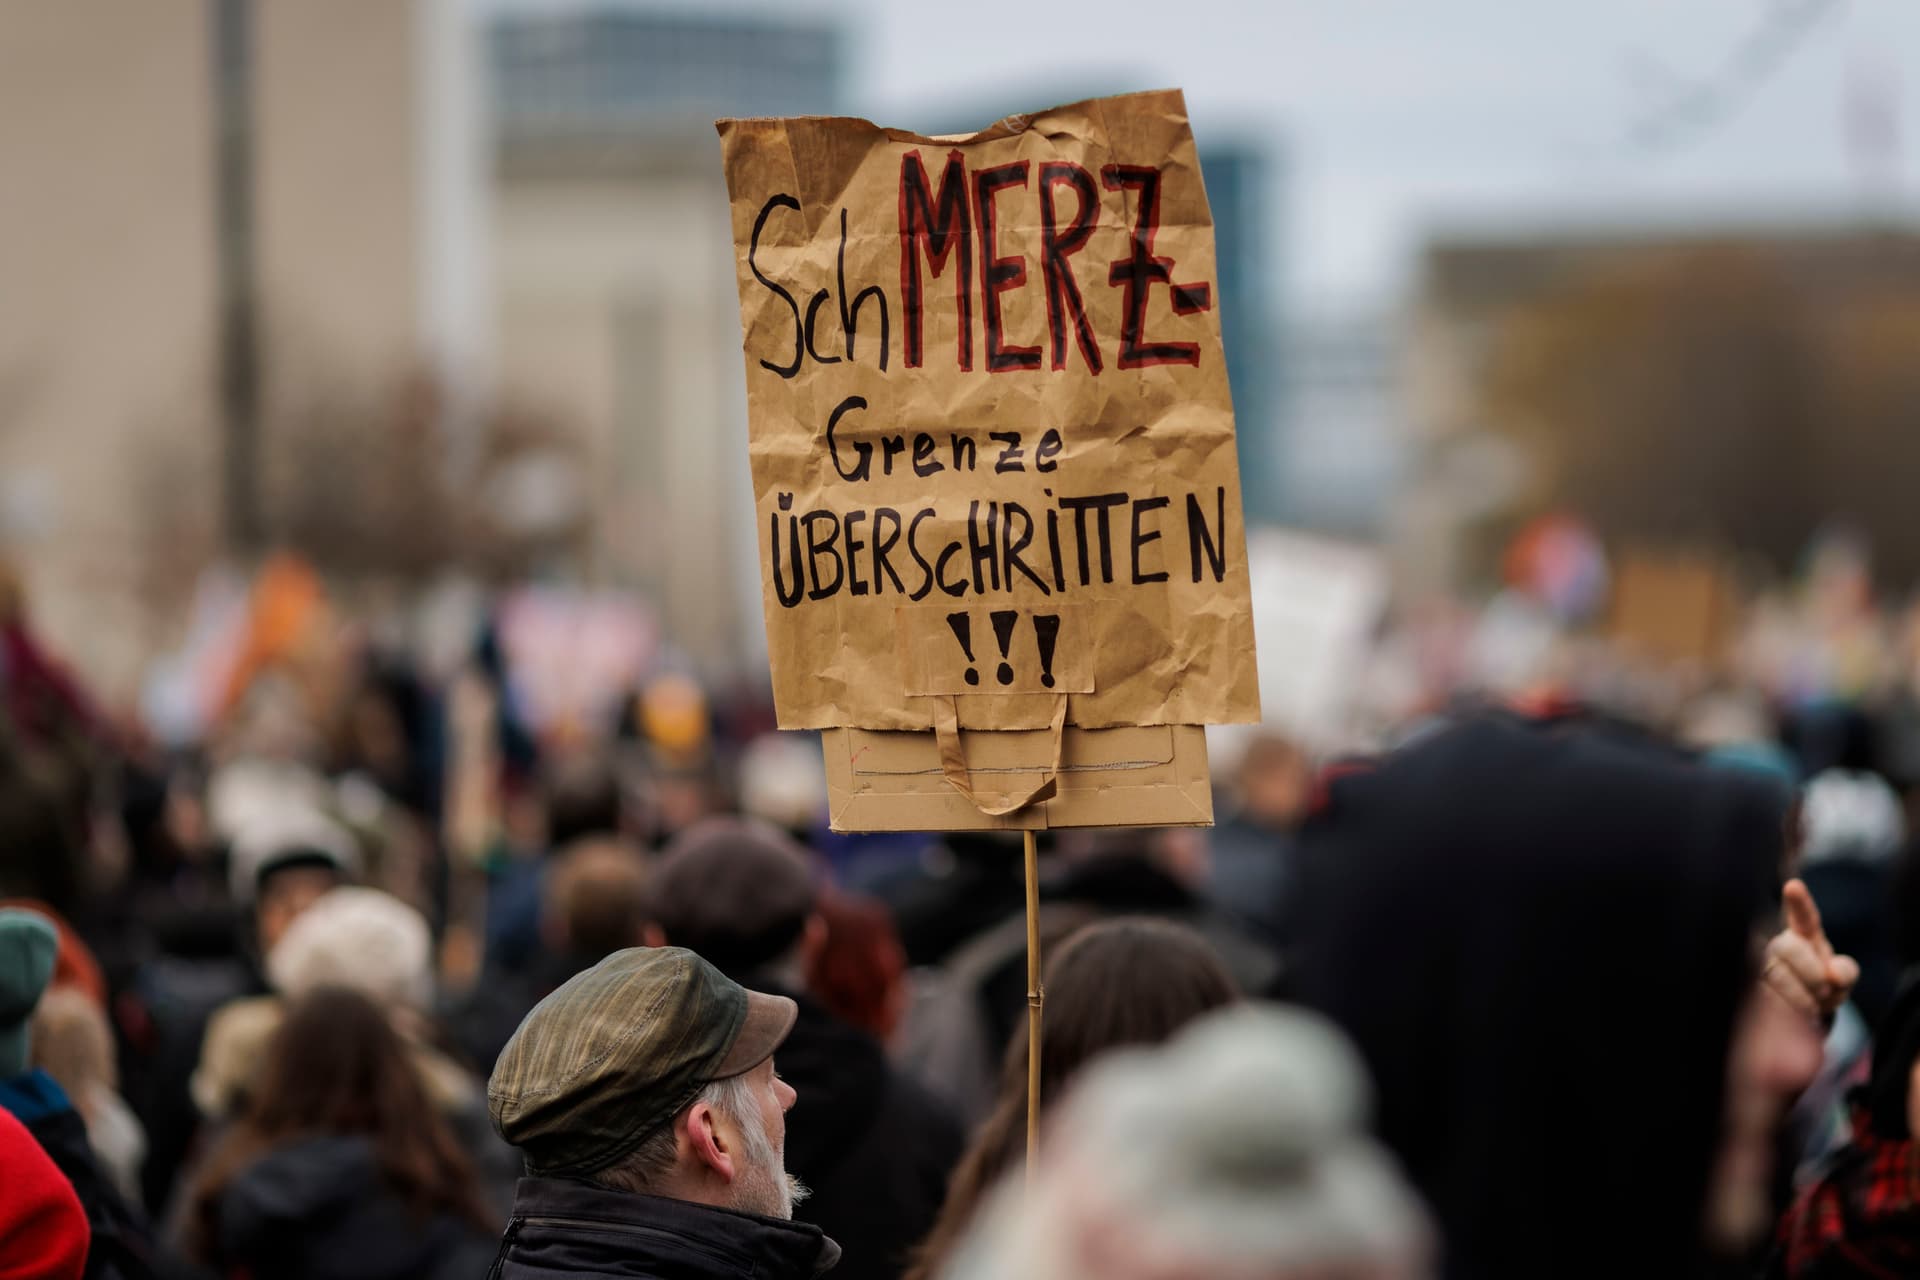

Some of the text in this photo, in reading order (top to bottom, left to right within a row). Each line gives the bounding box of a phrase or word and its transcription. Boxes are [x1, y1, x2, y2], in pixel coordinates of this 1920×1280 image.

[749, 149, 1210, 378] SchMERZ-
[826, 396, 1063, 482] Grenze
[946, 610, 1060, 688] !!!
